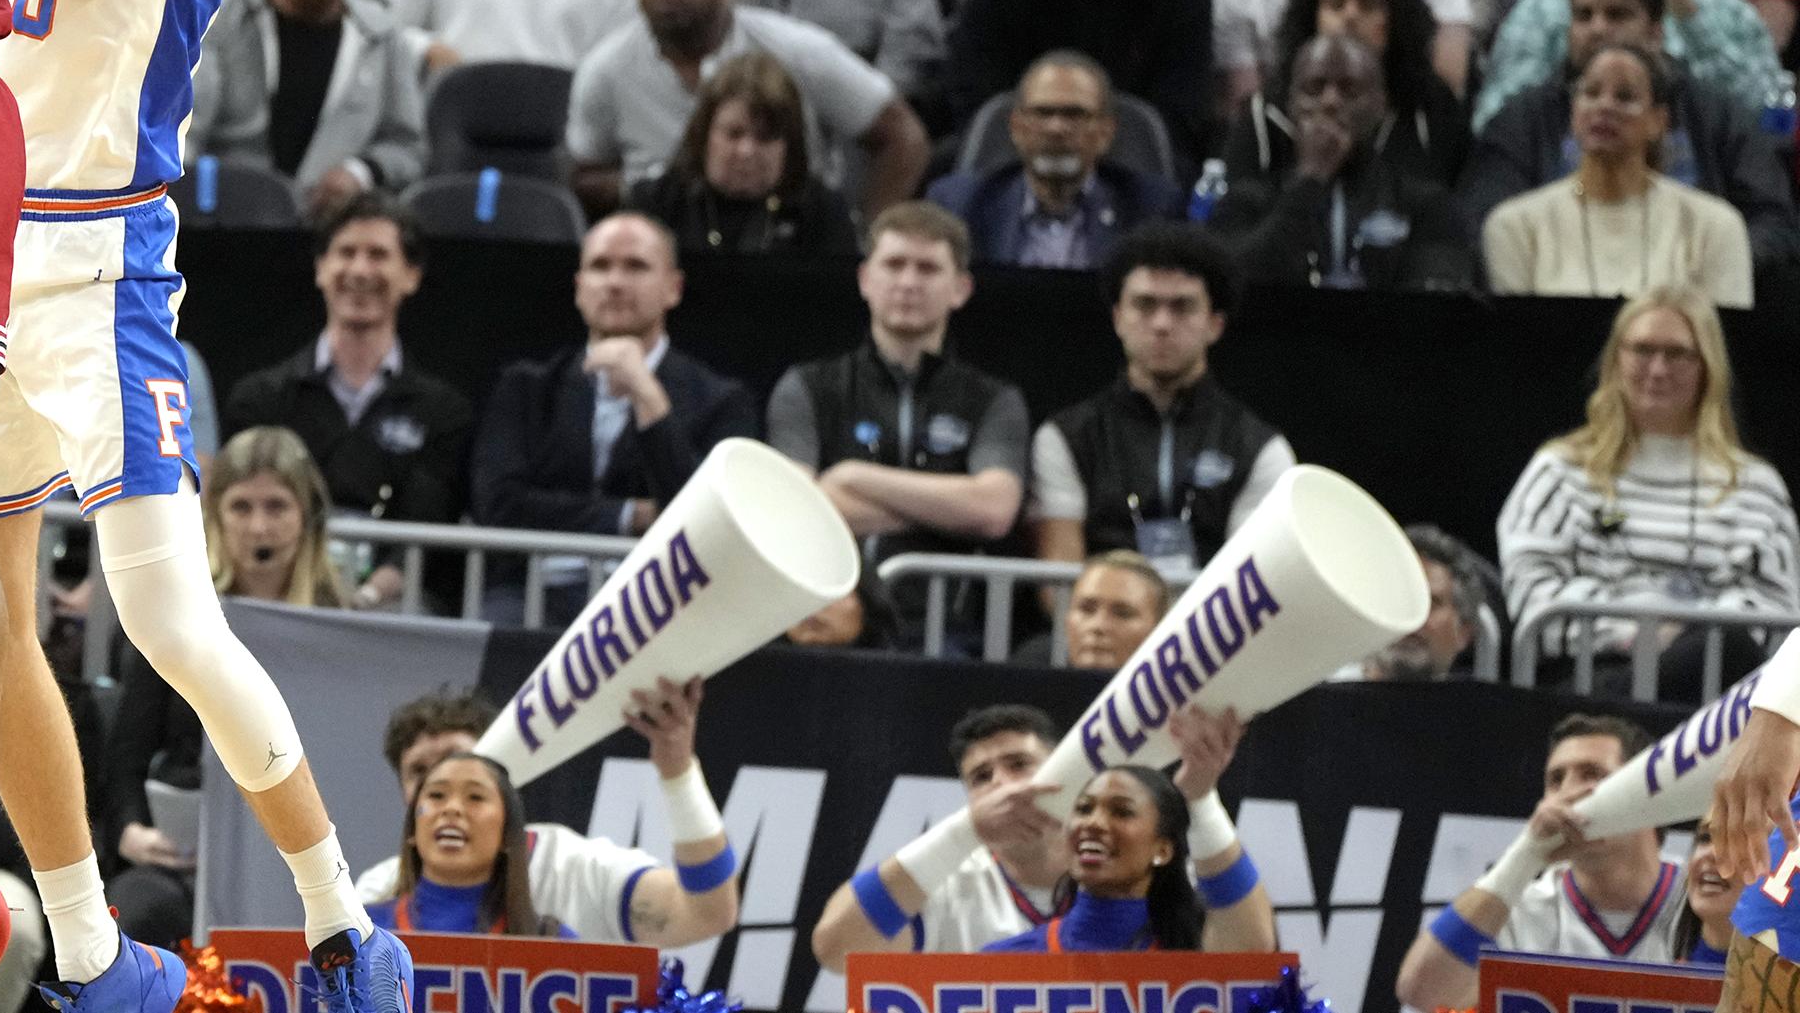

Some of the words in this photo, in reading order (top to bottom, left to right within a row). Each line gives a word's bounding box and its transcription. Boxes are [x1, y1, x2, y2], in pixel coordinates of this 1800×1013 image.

[145, 378, 186, 457] F
[515, 527, 710, 754] FLORIDA
[1080, 554, 1282, 773] FLORIDA
